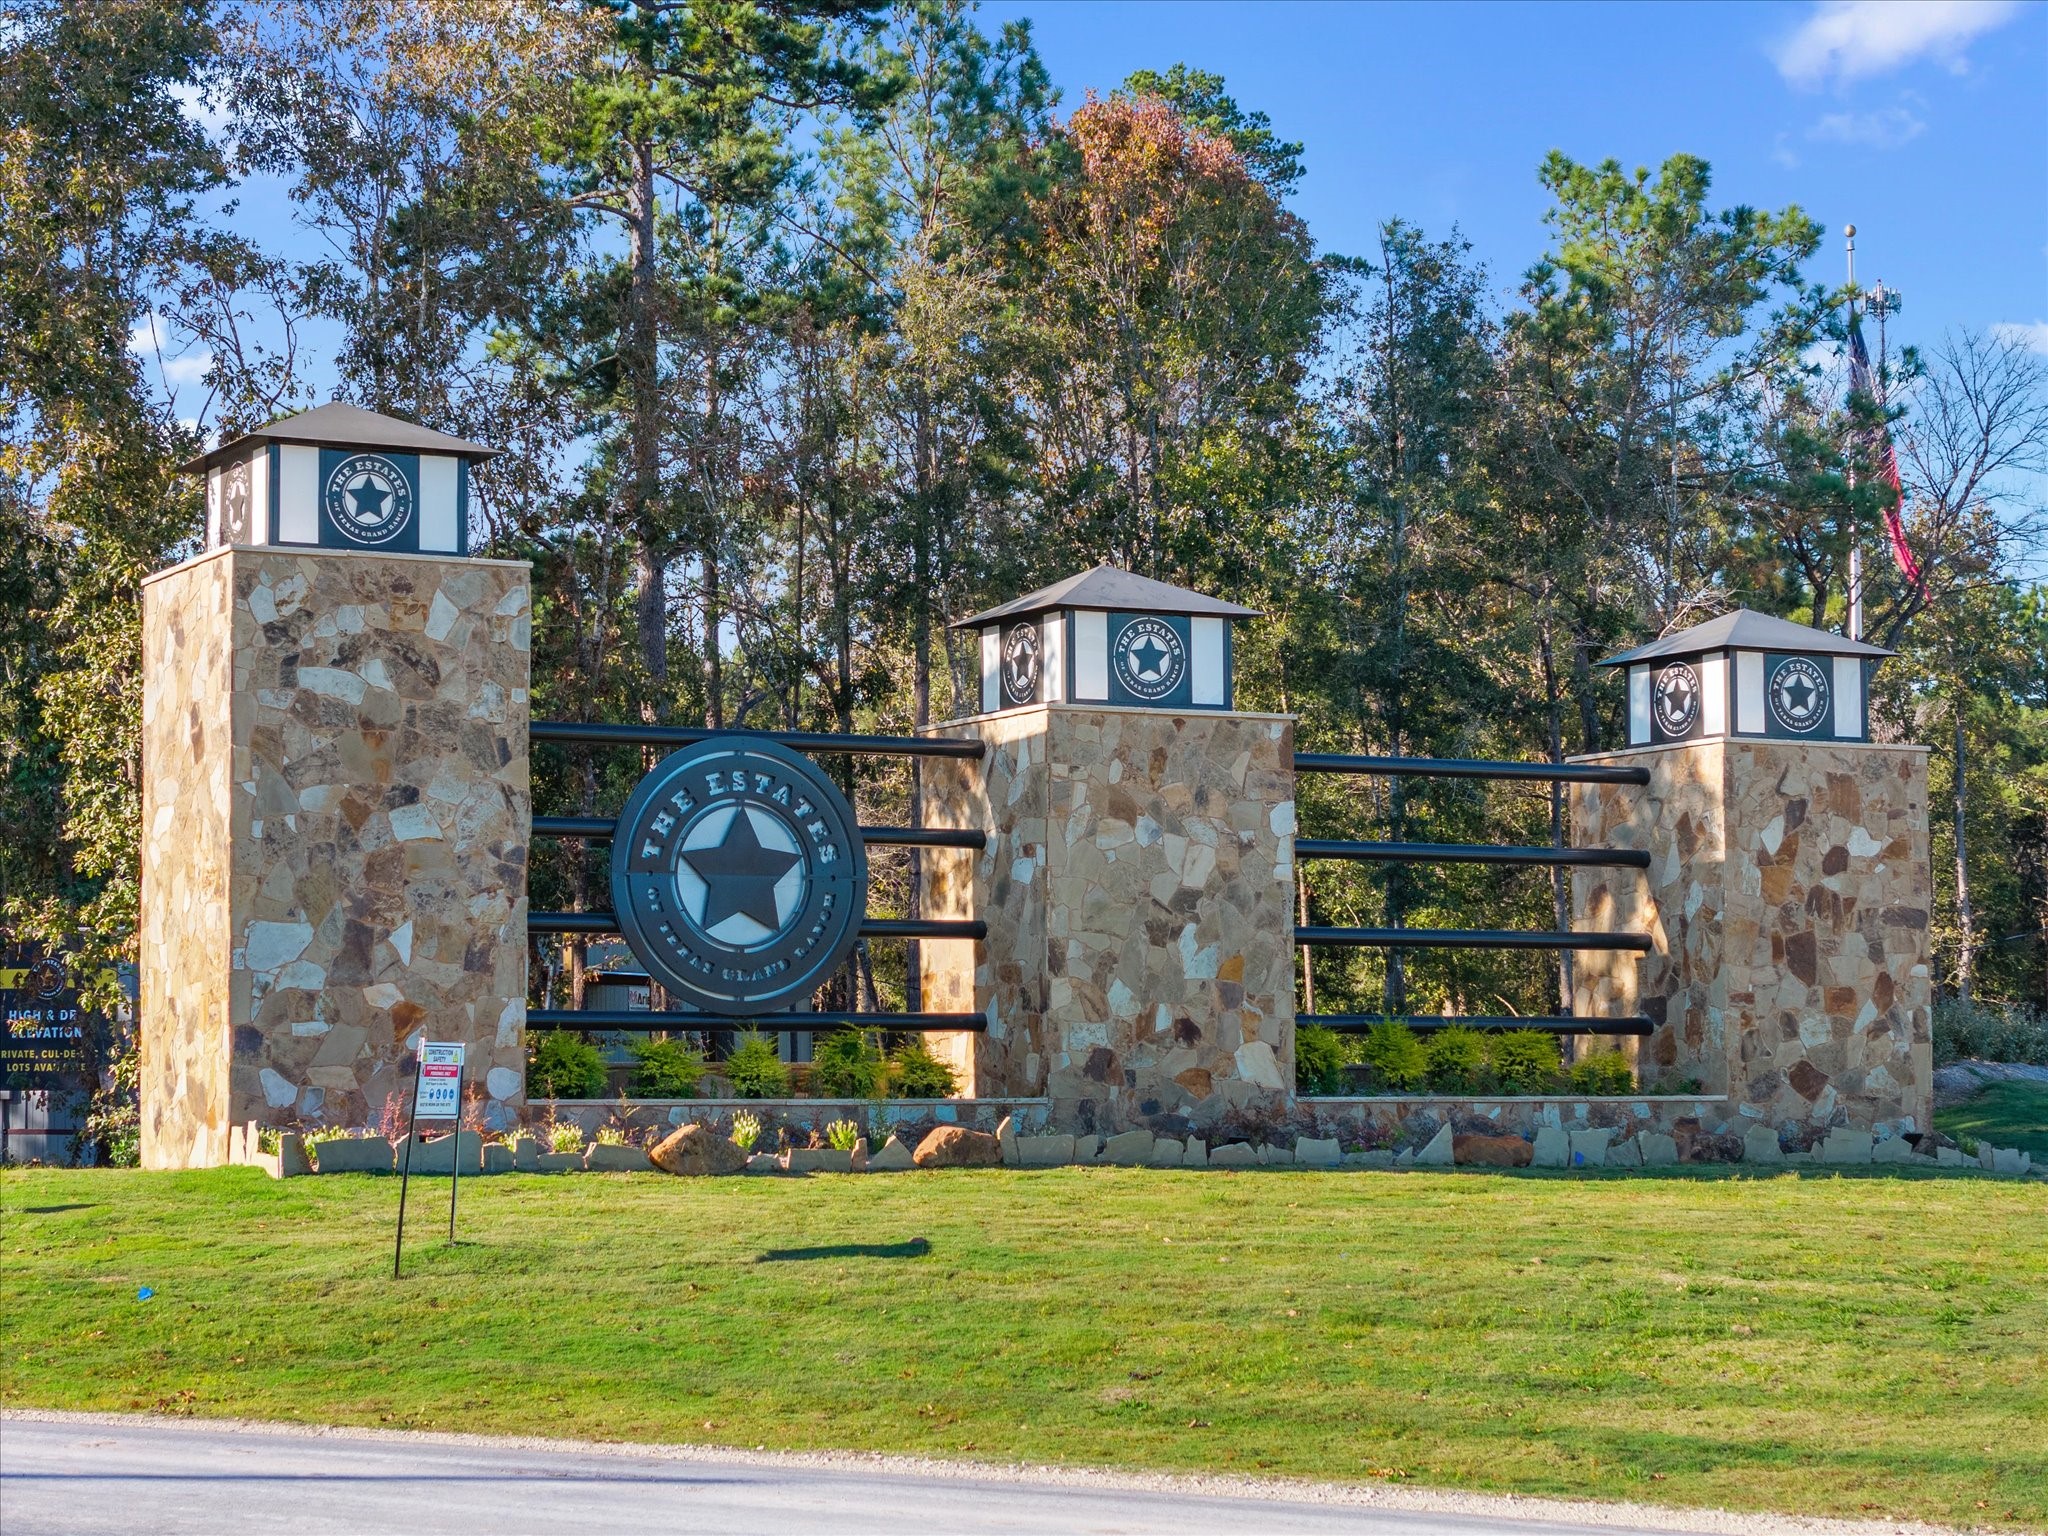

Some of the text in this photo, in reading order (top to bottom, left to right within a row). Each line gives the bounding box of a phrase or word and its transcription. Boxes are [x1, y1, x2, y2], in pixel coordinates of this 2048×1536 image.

[331, 461, 406, 497] THE ESTATES
[333, 501, 405, 537] OF TEXAS GRAND RANCH
[1118, 623, 1181, 656] THE ESTATES
[1657, 667, 1698, 698] THE ESTATES
[1773, 663, 1825, 692] THE ESTATES
[641, 769, 842, 865] THE ESTATES
[9, 1009, 41, 1021] HIGH
[46, 1009, 55, 1021] &
[0, 1049, 39, 1059] RIVATE,
[6, 1063, 31, 1072] LOTS
